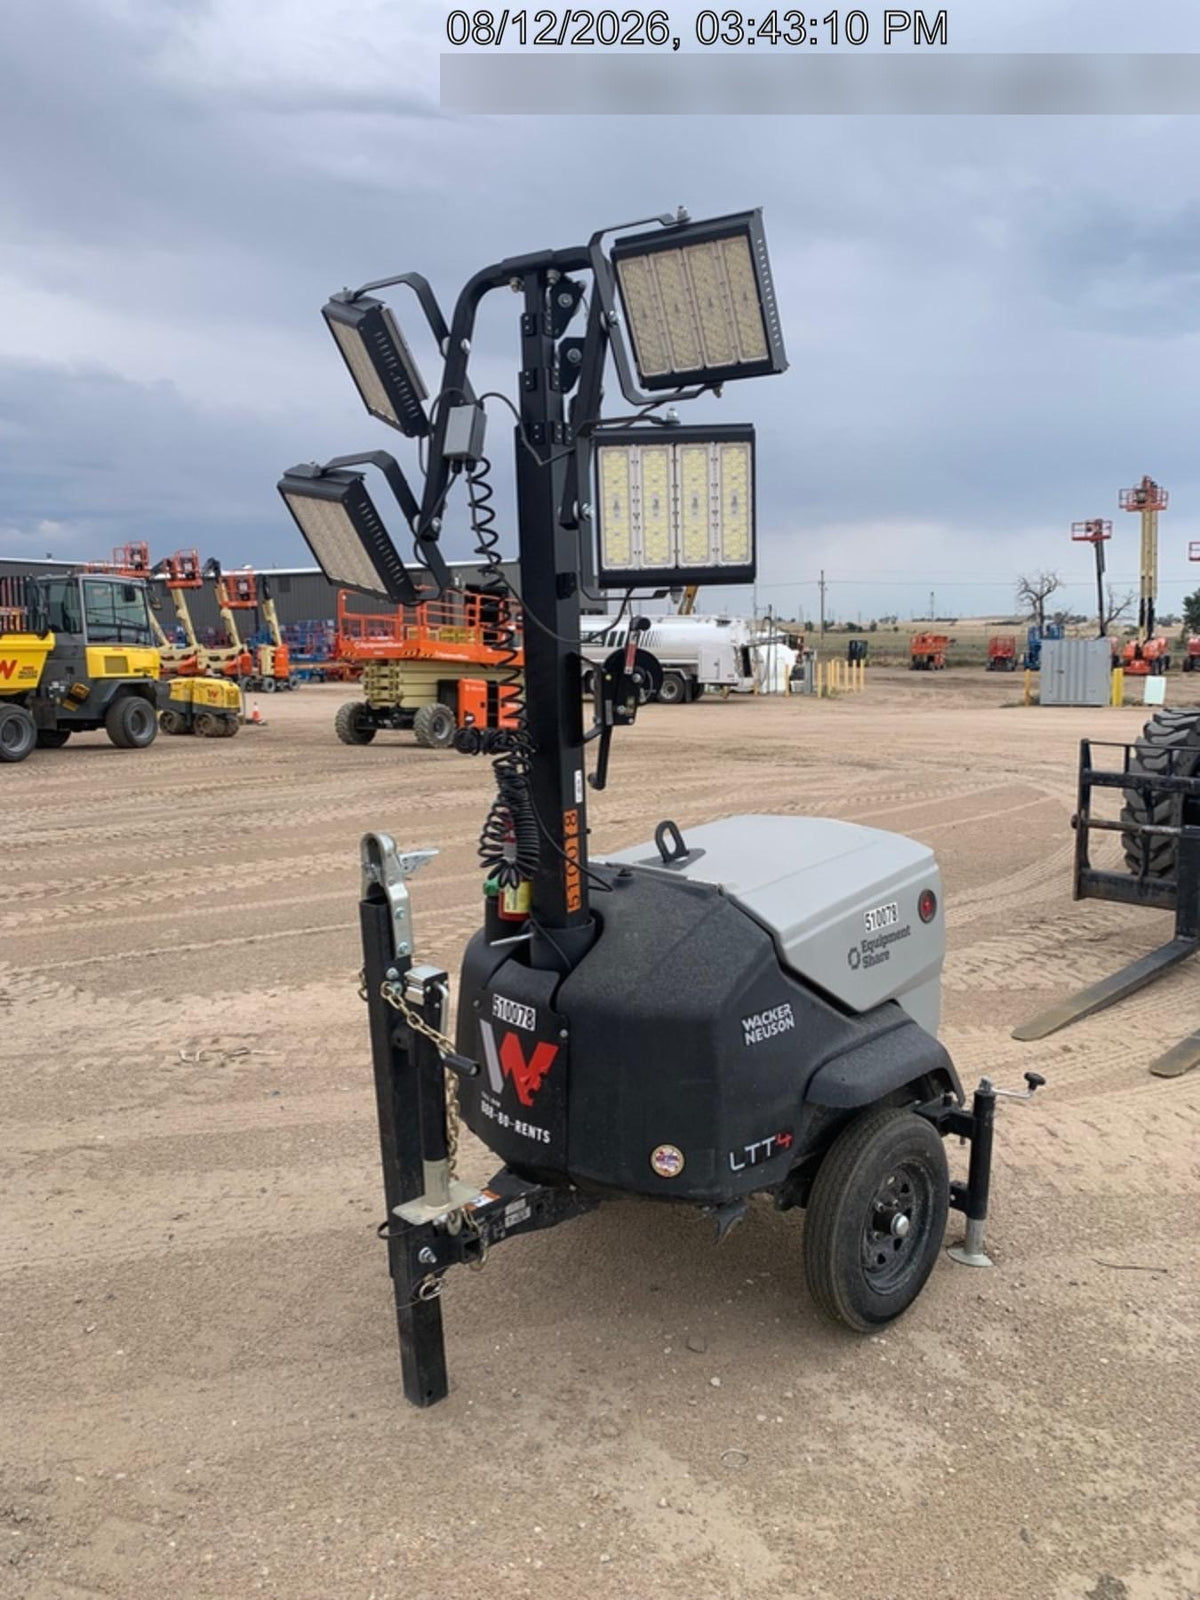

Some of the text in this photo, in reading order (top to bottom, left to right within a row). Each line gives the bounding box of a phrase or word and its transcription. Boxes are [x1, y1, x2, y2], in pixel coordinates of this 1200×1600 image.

[564, 811, 580, 909] 51008
[865, 903, 898, 931] 510078
[861, 925, 911, 953] Equipment
[862, 950, 890, 969] Share
[494, 996, 535, 1029] 510078
[741, 1003, 792, 1031] WACKER
[744, 1014, 795, 1046] NEUSON
[729, 1132, 793, 1171] LTT4
